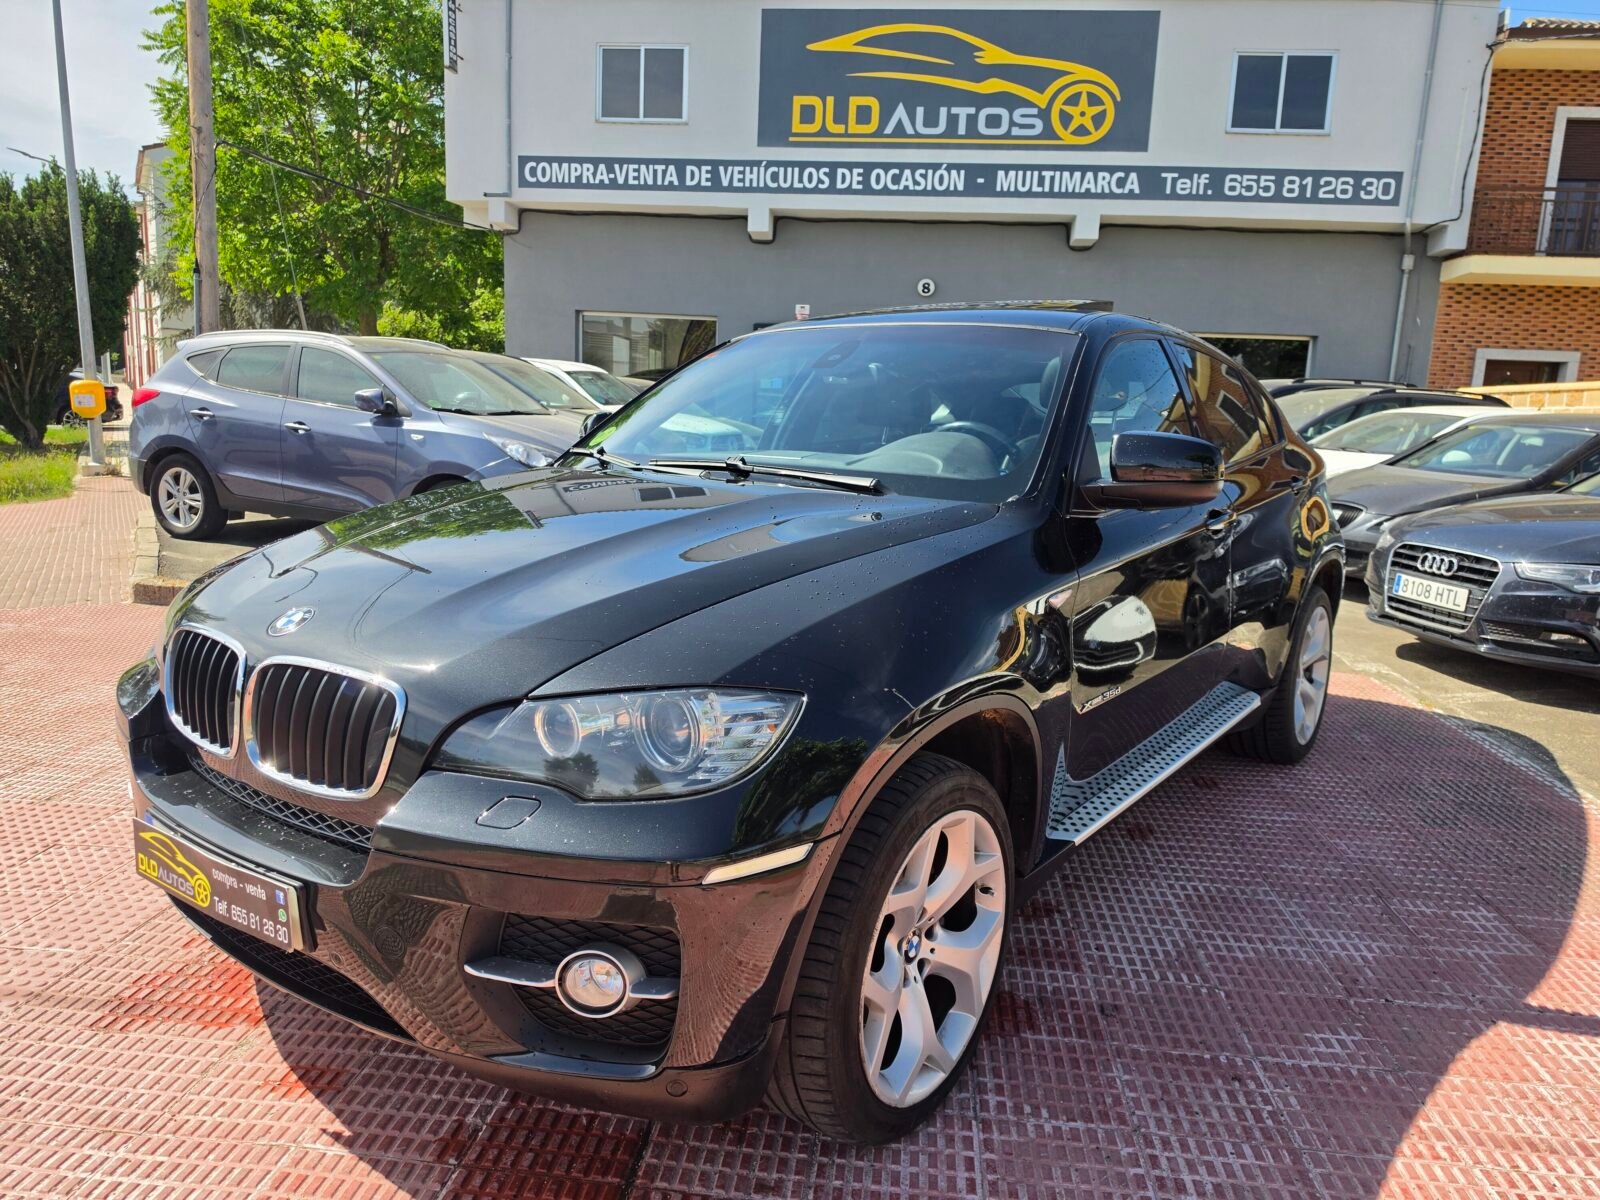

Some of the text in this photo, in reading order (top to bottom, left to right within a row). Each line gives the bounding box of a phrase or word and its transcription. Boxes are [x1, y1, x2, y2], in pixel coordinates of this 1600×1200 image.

[791, 95, 1043, 136] DLD AUTOS
[524, 161, 679, 186] COMPRA-VENTA
[685, 165, 711, 187] DE
[718, 160, 829, 189] VEHÍCULOS
[836, 167, 863, 190] DE
[870, 164, 966, 192] OCASIÓN
[996, 169, 1140, 194] MULTIMARCA
[1161, 172, 1213, 195] Telf.
[1224, 174, 1276, 197] 655
[1282, 176, 1313, 198] 81
[1318, 176, 1354, 199] 26
[1360, 178, 1396, 201] 30
[921, 282, 931, 294] 8
[1401, 578, 1461, 608] 8108 HTL
[138, 852, 194, 896] DLD AUTOS
[212, 868, 238, 889] compra
[245, 882, 266, 901] venta
[213, 896, 288, 944] Telf. 655 81 26 30
